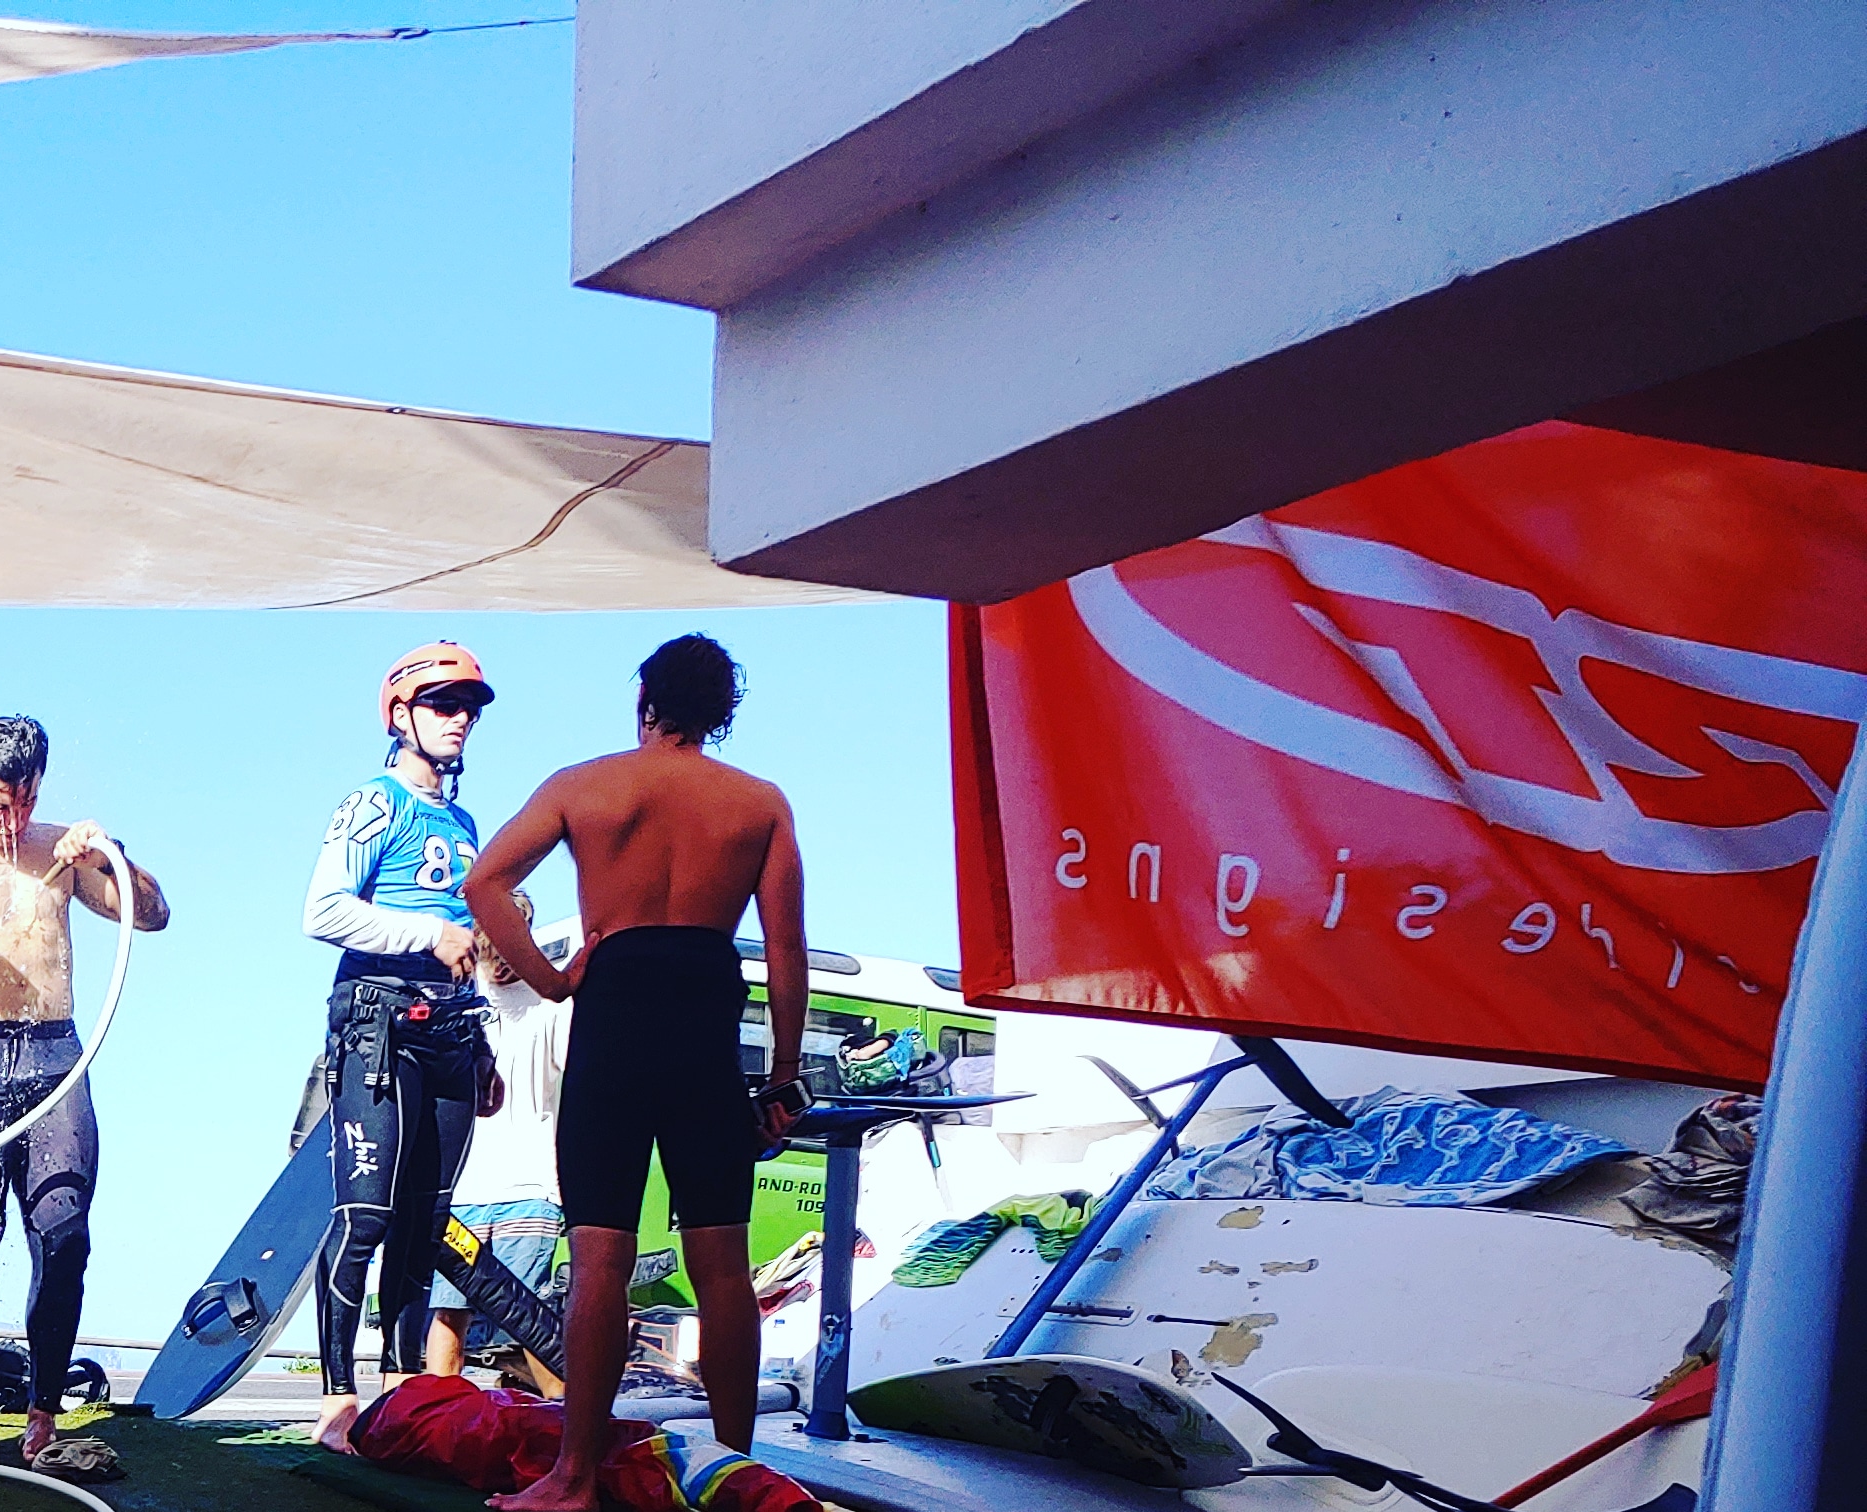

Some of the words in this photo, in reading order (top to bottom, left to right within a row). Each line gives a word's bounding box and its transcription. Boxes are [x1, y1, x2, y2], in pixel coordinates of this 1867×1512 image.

[323, 790, 391, 845] 87
[414, 834, 480, 893] 87
[343, 1121, 379, 1181] Zhik
[757, 1177, 821, 1195] AND-RO
[796, 1199, 825, 1213] 109
